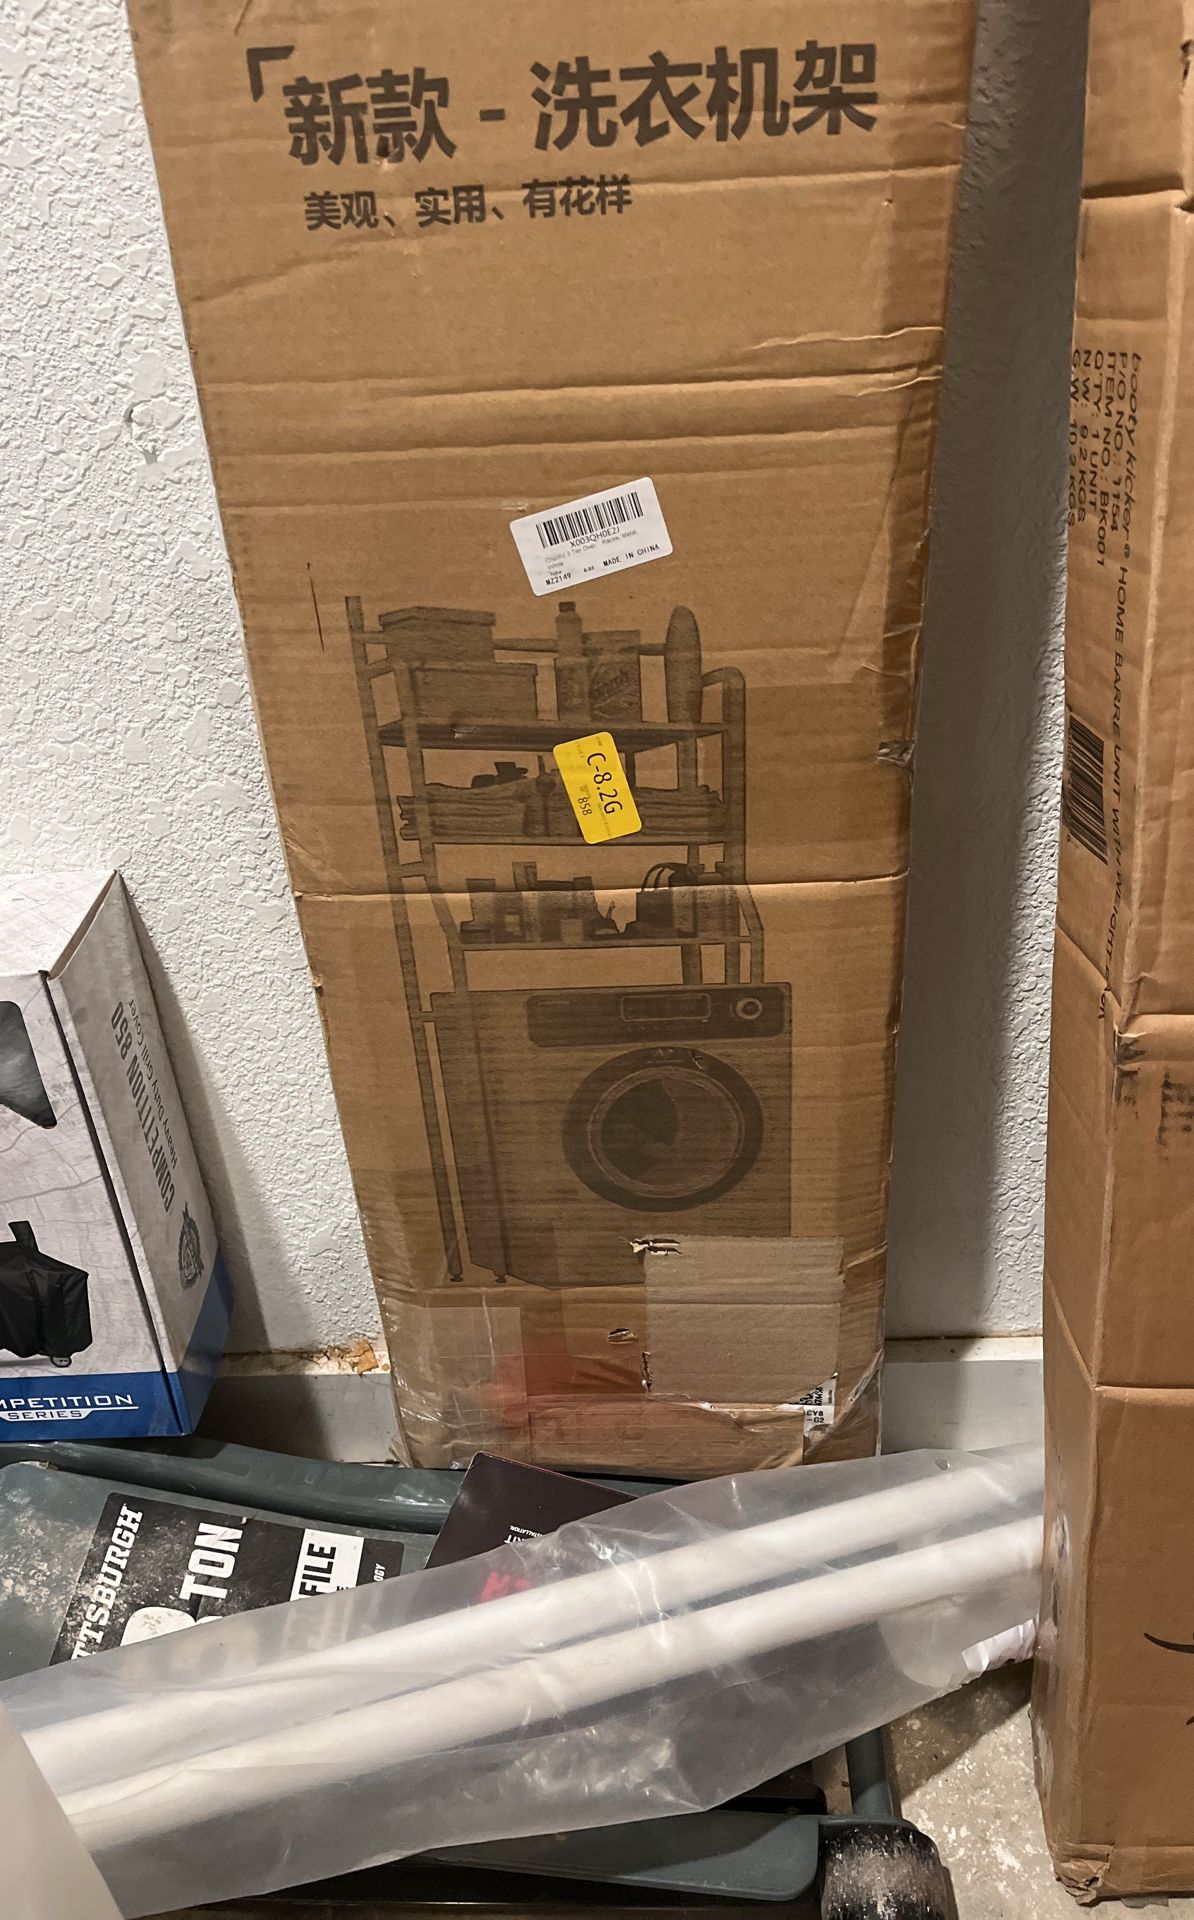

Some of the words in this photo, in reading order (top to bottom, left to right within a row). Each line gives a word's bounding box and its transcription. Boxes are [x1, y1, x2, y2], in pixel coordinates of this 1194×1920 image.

[530, 40, 880, 150] 洗衣机架
[304, 174, 633, 232] 美观、实用、有花样
[1104, 351, 1116, 417] ITEM
[1117, 352, 1128, 400] P/O
[1125, 352, 1142, 446] booty
[1078, 470, 1087, 522] KGS
[1088, 451, 1099, 512] UNIT
[1111, 475, 1121, 532] 1154
[603, 556, 621, 567] MADE
[625, 552, 634, 560] IN
[637, 544, 660, 557] CHINA
[1097, 490, 1109, 566] BK001
[1115, 566, 1128, 644] HOME
[1112, 651, 1123, 740] BARRE
[587, 752, 623, 814] C-8.2G
[1113, 744, 1121, 802] UNIT
[577, 797, 592, 816] 858
[1112, 808, 1121, 866] WITH
[1105, 872, 1121, 962] WEIGHT
[111, 1001, 133, 1060] 850
[129, 999, 144, 1046] Cover
[141, 1044, 154, 1080] Grill
[151, 1079, 165, 1121] Duty
[127, 1053, 175, 1213] COMPETITION
[163, 1118, 178, 1169] Heavy
[8, 1410, 82, 1420] SERIES
[179, 1522, 243, 1599] TON
